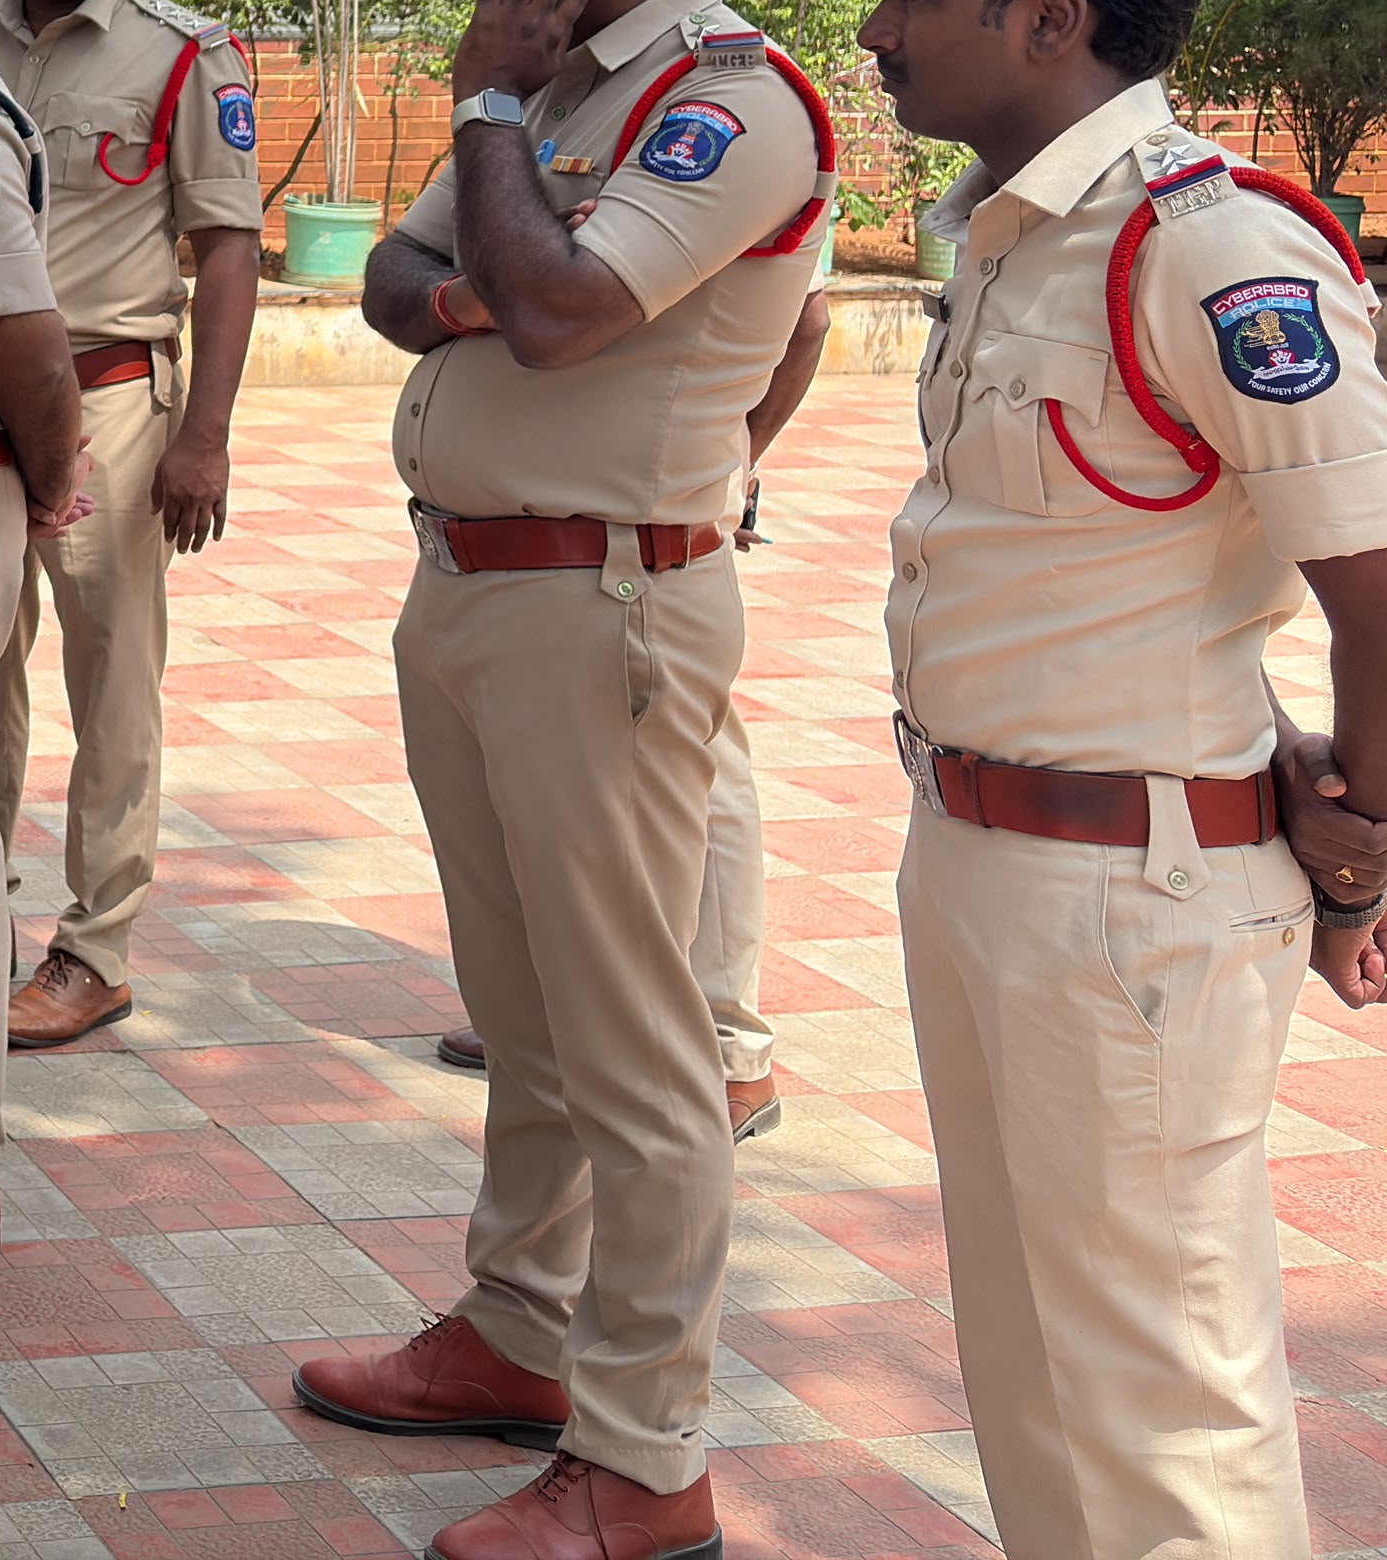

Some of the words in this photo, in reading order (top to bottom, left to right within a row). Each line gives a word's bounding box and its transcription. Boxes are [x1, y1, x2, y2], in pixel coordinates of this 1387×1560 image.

[1212, 284, 1309, 315] CYBERABAD
[1230, 297, 1295, 319] POLICE
[1247, 378, 1267, 392] YOUR
[1266, 385, 1292, 396] SAFETY
[1293, 383, 1309, 394] OUR
[1308, 361, 1332, 389] CONCERN
